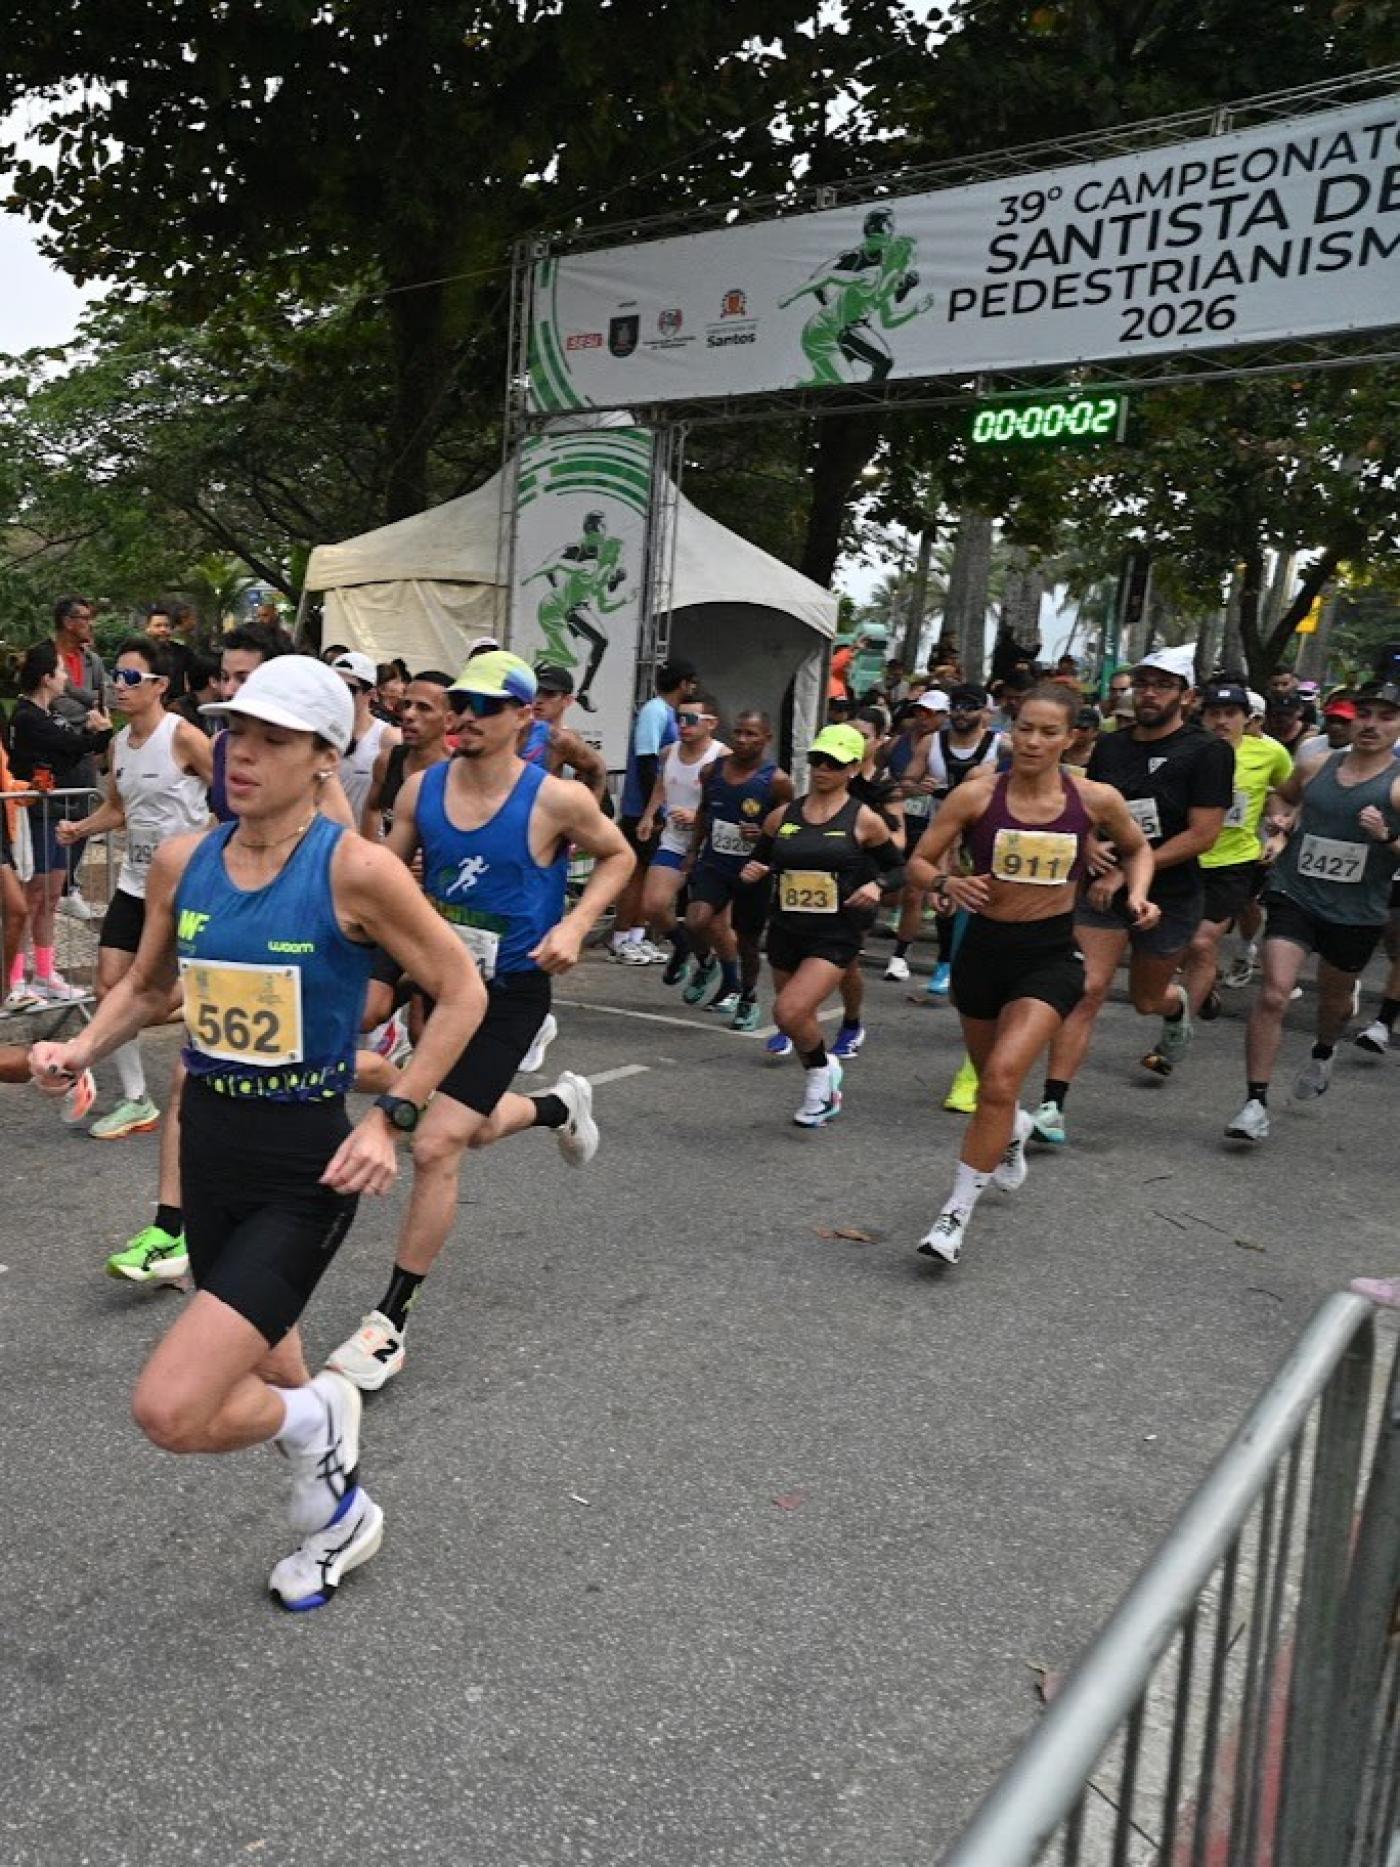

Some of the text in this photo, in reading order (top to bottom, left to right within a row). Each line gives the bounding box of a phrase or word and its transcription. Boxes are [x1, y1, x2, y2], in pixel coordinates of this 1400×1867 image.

[1074, 120, 1400, 214] CAMPEONAT
[986, 164, 1400, 274] SANTISTA DE
[947, 226, 1400, 322] PEDESTRIANISM
[706, 333, 756, 349] Santos
[1119, 295, 1236, 342] 2026
[972, 400, 1116, 443] 00:00:02
[1003, 853, 1061, 880] 911
[1300, 853, 1360, 877] 2427
[786, 888, 828, 908] 823
[197, 1003, 281, 1054] 562
